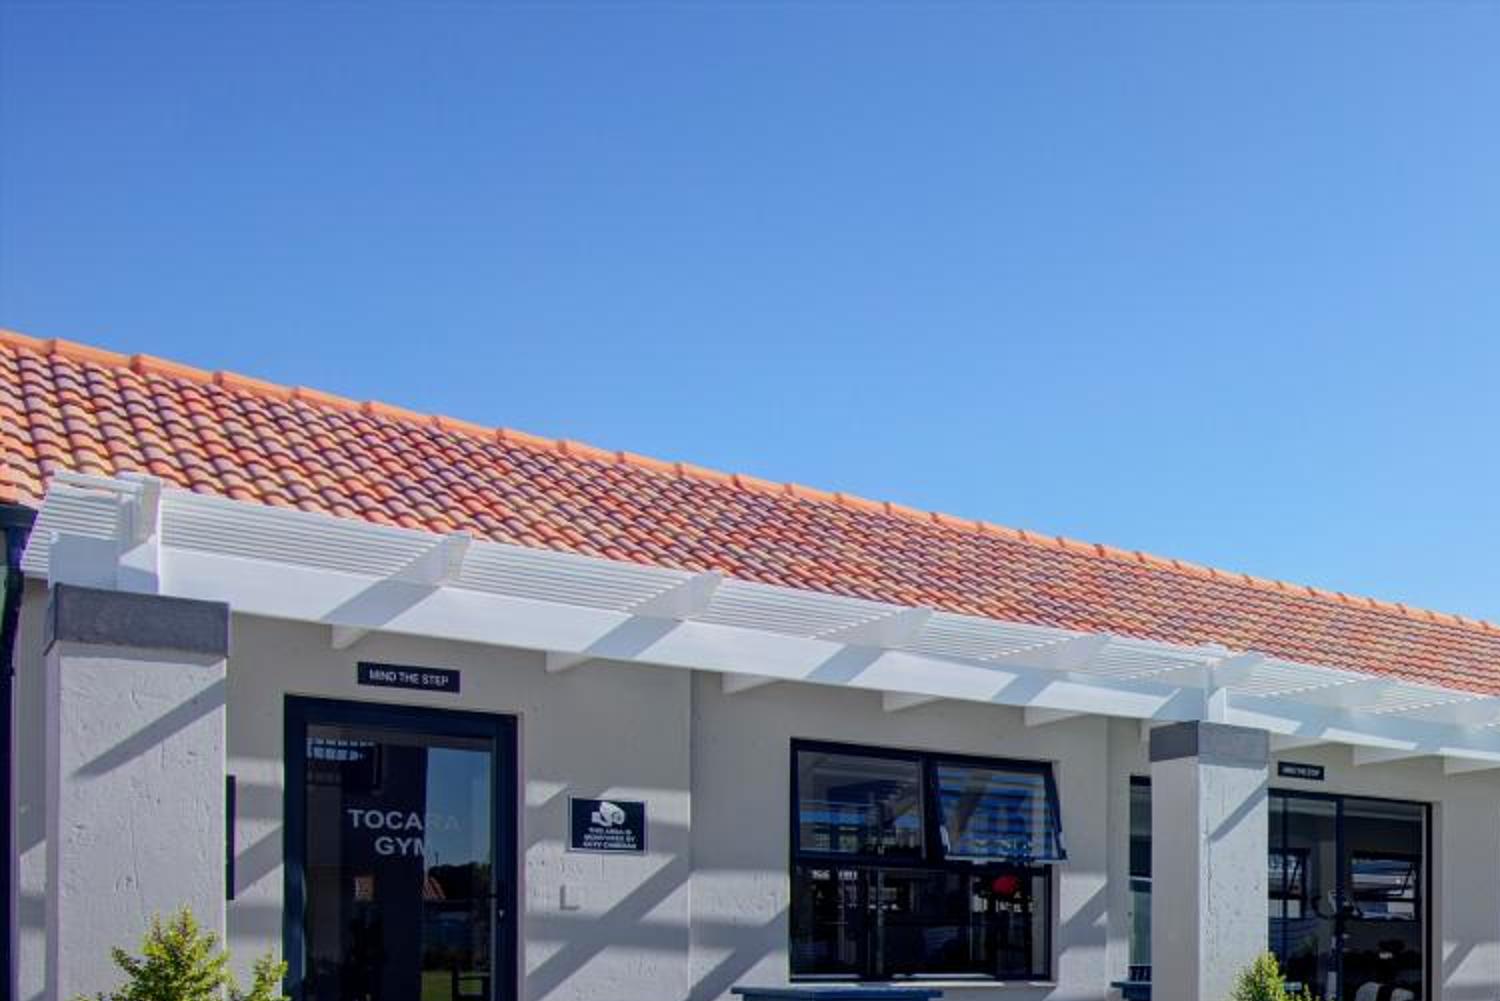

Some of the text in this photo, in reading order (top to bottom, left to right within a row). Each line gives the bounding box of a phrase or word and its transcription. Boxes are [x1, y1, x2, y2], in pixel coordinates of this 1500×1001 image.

[399, 671, 419, 684] THE
[421, 674, 449, 686] STEP
[375, 836, 433, 857] GYM
